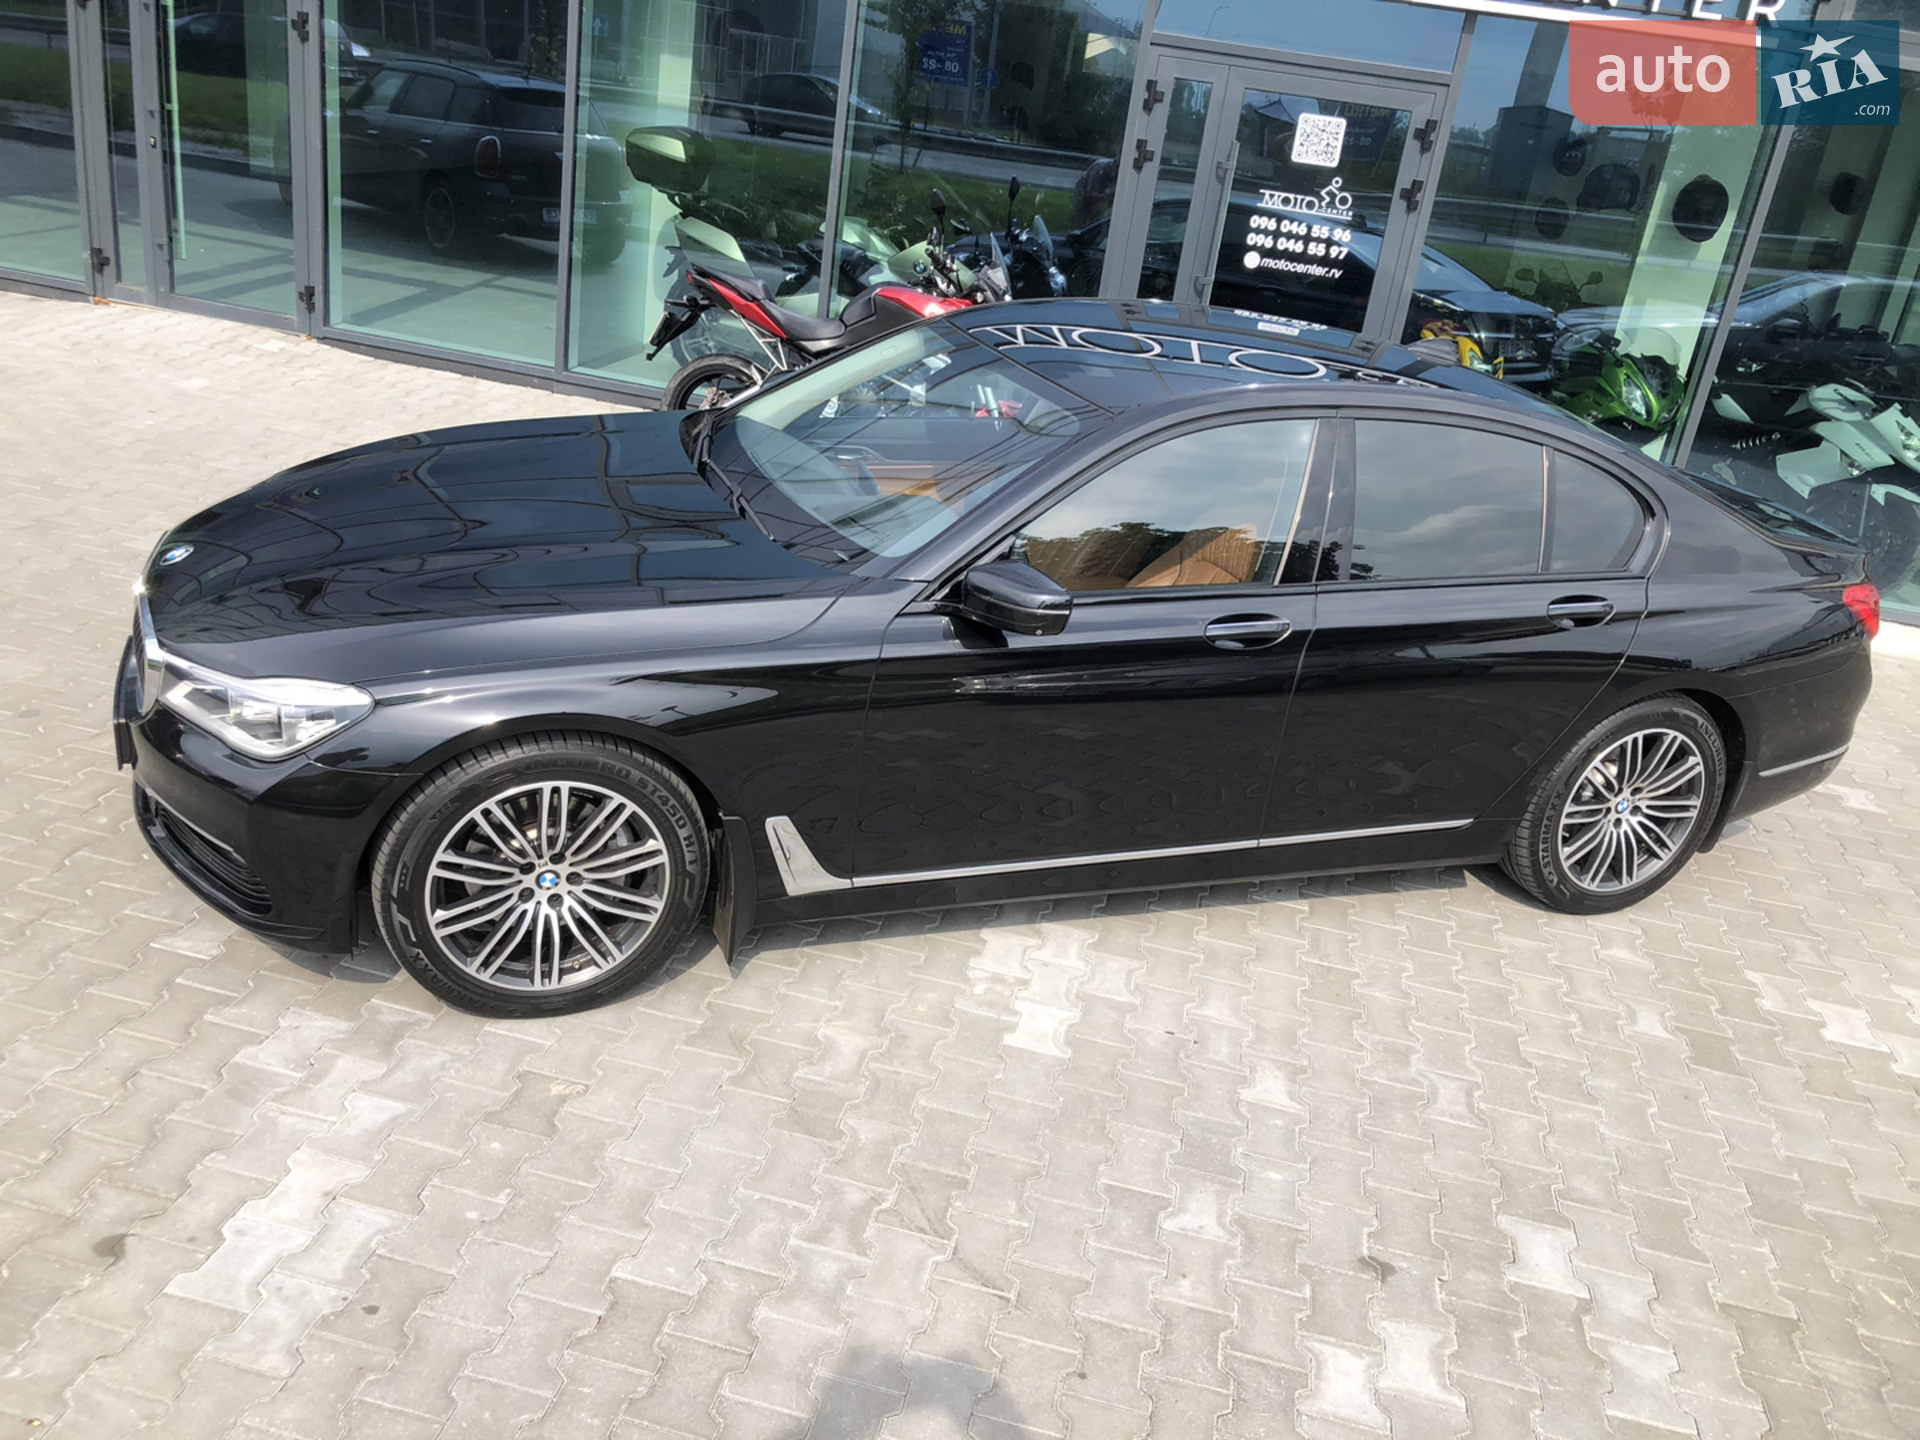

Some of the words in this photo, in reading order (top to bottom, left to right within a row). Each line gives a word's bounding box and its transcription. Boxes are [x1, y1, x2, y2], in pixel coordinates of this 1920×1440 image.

[1260, 189, 1319, 213] MOTO
[1321, 207, 1353, 217] CENTER
[1250, 215, 1277, 231] 096
[1280, 219, 1307, 235] 046
[1310, 224, 1329, 239] 55
[1333, 228, 1352, 242] 96
[1246, 232, 1274, 248] 096
[1276, 237, 1304, 253] 046
[1307, 241, 1326, 256] 55
[1329, 245, 1349, 259] 97
[1260, 257, 1344, 279] motocenter.rv
[635, 775, 689, 830] ST450
[683, 833, 699, 867] H/T
[1541, 790, 1564, 869] STARMAXX
[409, 951, 498, 1013] STARMAXX
